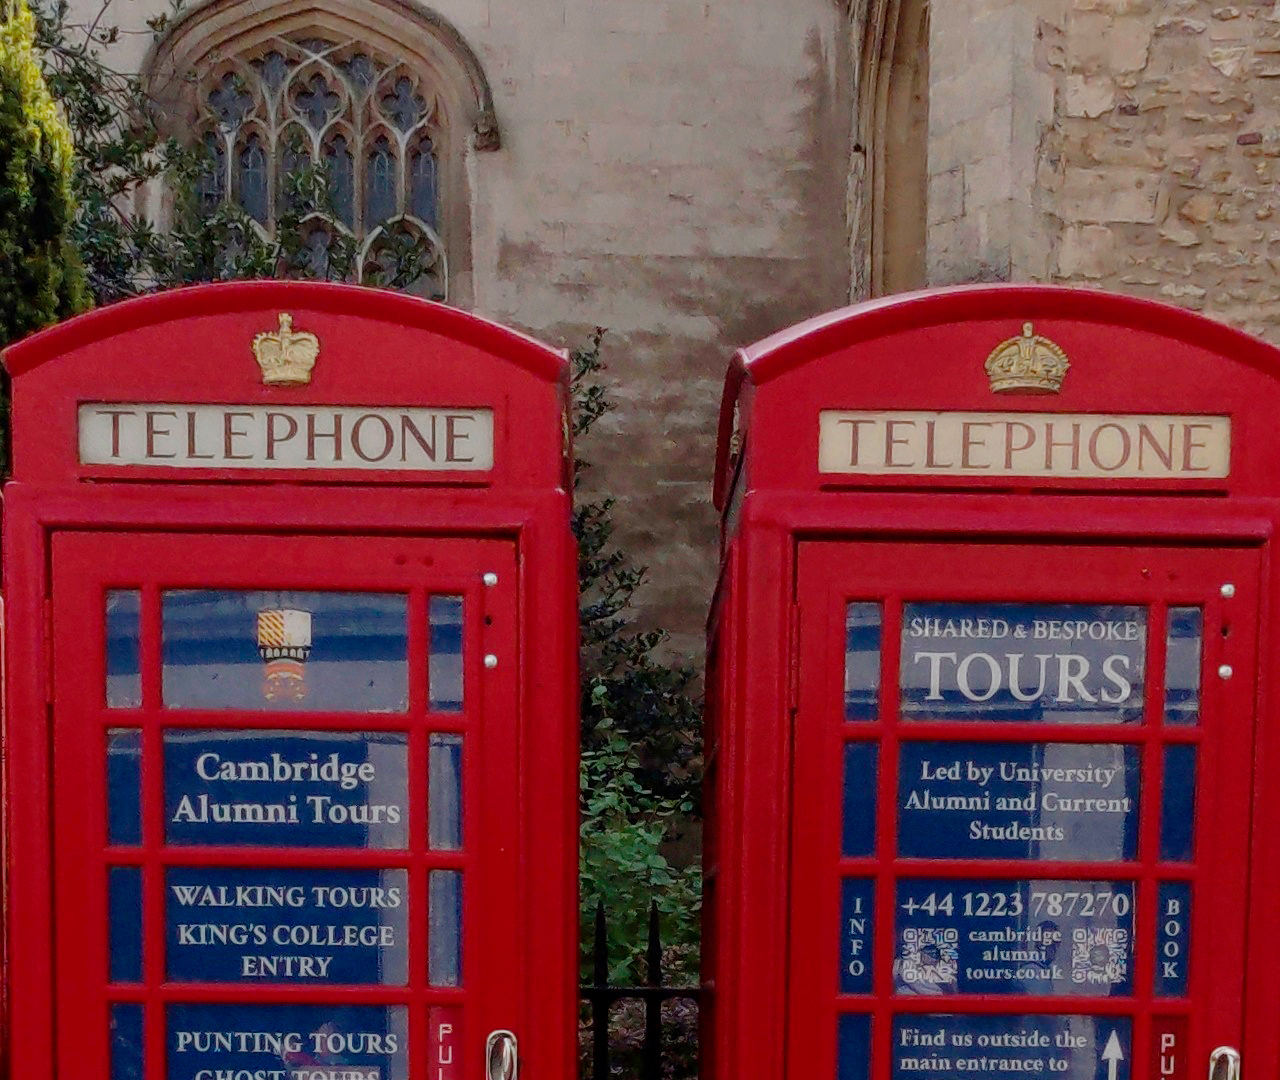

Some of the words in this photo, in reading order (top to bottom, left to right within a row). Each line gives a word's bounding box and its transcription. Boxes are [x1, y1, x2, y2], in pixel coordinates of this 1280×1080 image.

[96, 410, 477, 464] TELEPHONE
[837, 419, 1214, 473] TELEPHONE
[910, 617, 1010, 641] SHARED
[1015, 622, 1027, 638] &
[1033, 618, 1140, 641] BESPOKE
[914, 651, 1132, 702] TOURS
[196, 753, 376, 788] Cambridge
[921, 761, 961, 782] Led
[968, 761, 993, 786] by
[999, 762, 1117, 786] University
[172, 795, 300, 825] Alumni
[308, 797, 401, 825] Tours
[904, 790, 990, 812] Alumni
[996, 790, 1036, 812] and
[1042, 793, 1132, 814] Current
[969, 820, 1064, 842] Students
[170, 885, 305, 909] WALKING
[312, 886, 402, 910] TOURS
[902, 893, 954, 917] +44
[962, 893, 1023, 917] 1223
[1032, 893, 1130, 918] 787270
[177, 924, 267, 947] KING'S
[273, 925, 395, 948] COLLEGE
[848, 897, 865, 977] INFO
[969, 926, 1062, 946] cambridge
[1162, 899, 1181, 980] BOOK
[241, 955, 333, 977] ENTRY
[982, 946, 1047, 963] alumni
[966, 964, 1063, 982] tours.co.uk
[176, 1032, 303, 1054] PUNTING
[309, 1033, 399, 1054] TOURS
[900, 1029, 946, 1048] Find
[951, 1033, 973, 1048] us
[978, 1029, 1051, 1049] outside
[1055, 1030, 1088, 1049] the
[900, 1054, 950, 1072] main
[956, 1056, 1043, 1073] entrance
[1048, 1055, 1068, 1072] to
